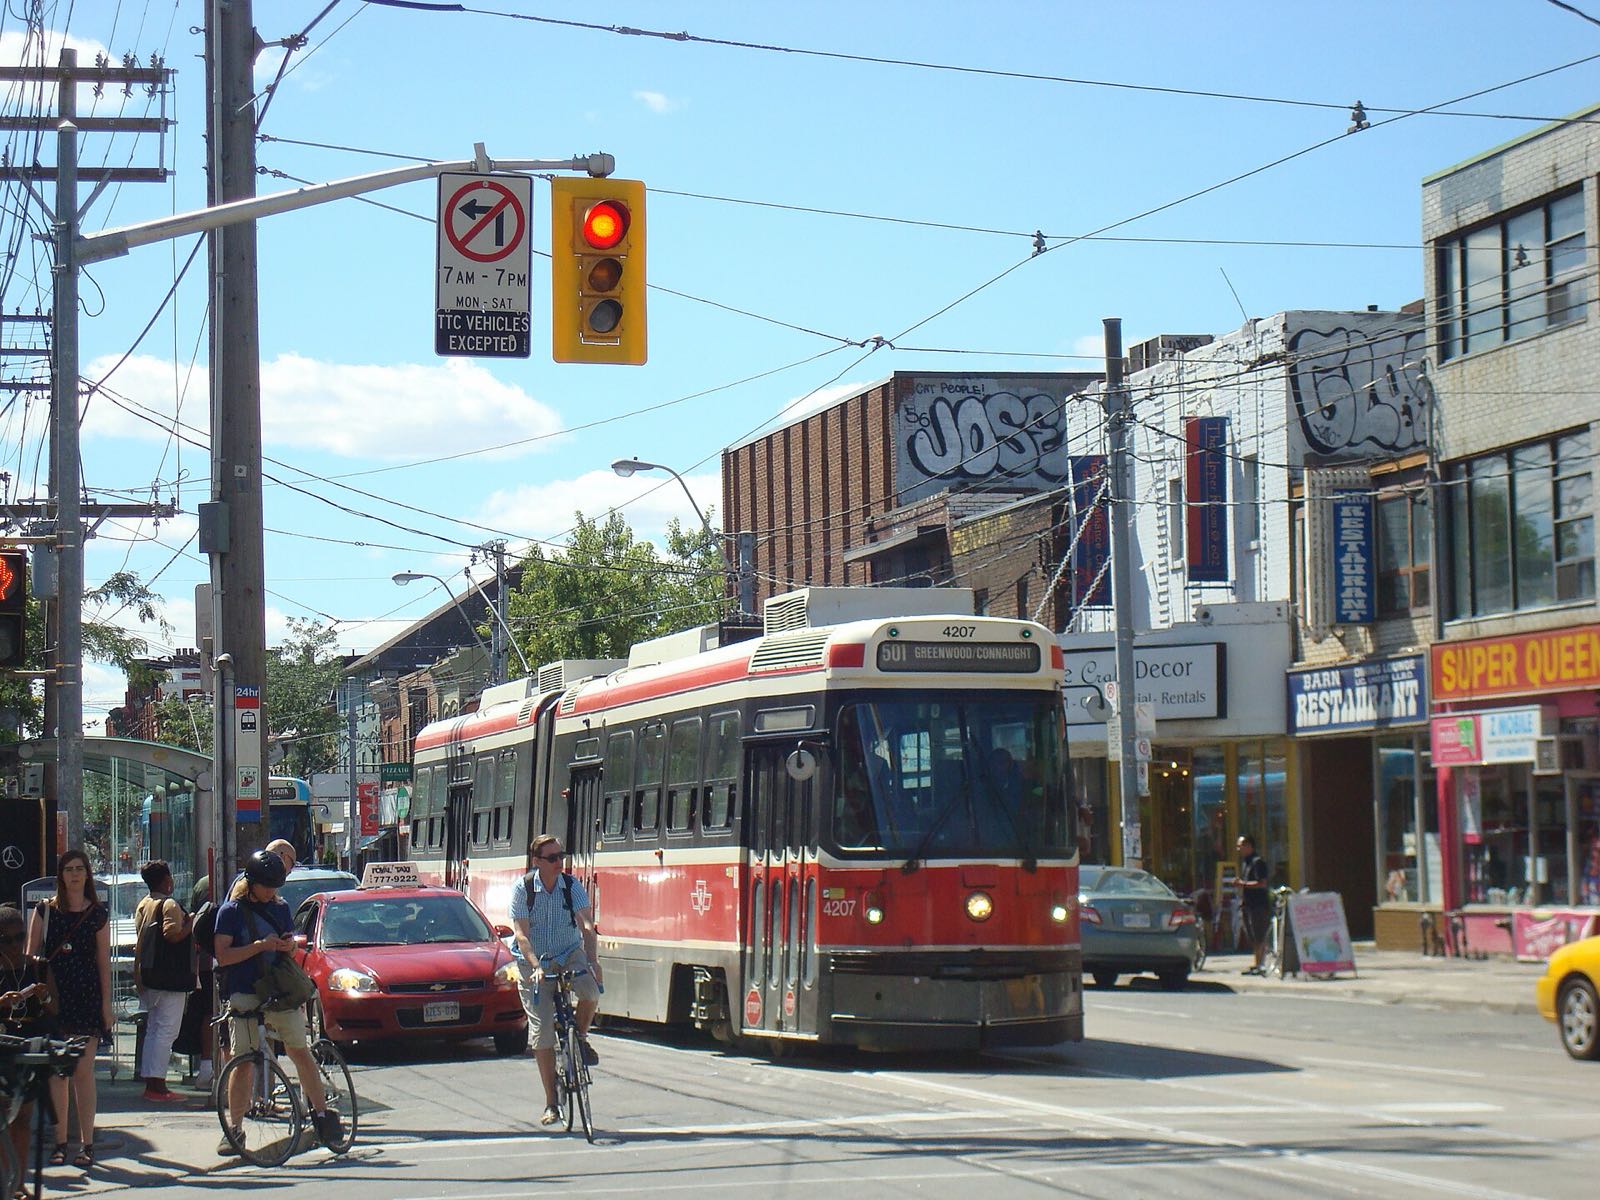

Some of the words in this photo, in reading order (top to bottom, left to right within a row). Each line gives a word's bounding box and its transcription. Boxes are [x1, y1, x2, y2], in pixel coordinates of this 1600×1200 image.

[437, 314, 462, 330] TTC
[466, 315, 529, 332] VEHICLES
[450, 335, 517, 352] EXCEPTED
[1340, 506, 1367, 620] RESTAURANT
[943, 626, 976, 638] 4207
[882, 644, 906, 661] 501
[1136, 659, 1193, 679] Decor
[1441, 643, 1518, 691] SUPER
[1303, 670, 1341, 691] BARN
[236, 687, 259, 697] 24hr
[1162, 690, 1206, 705] Rentals
[1296, 679, 1419, 728] RESTAURANT
[823, 900, 856, 916] 4207
